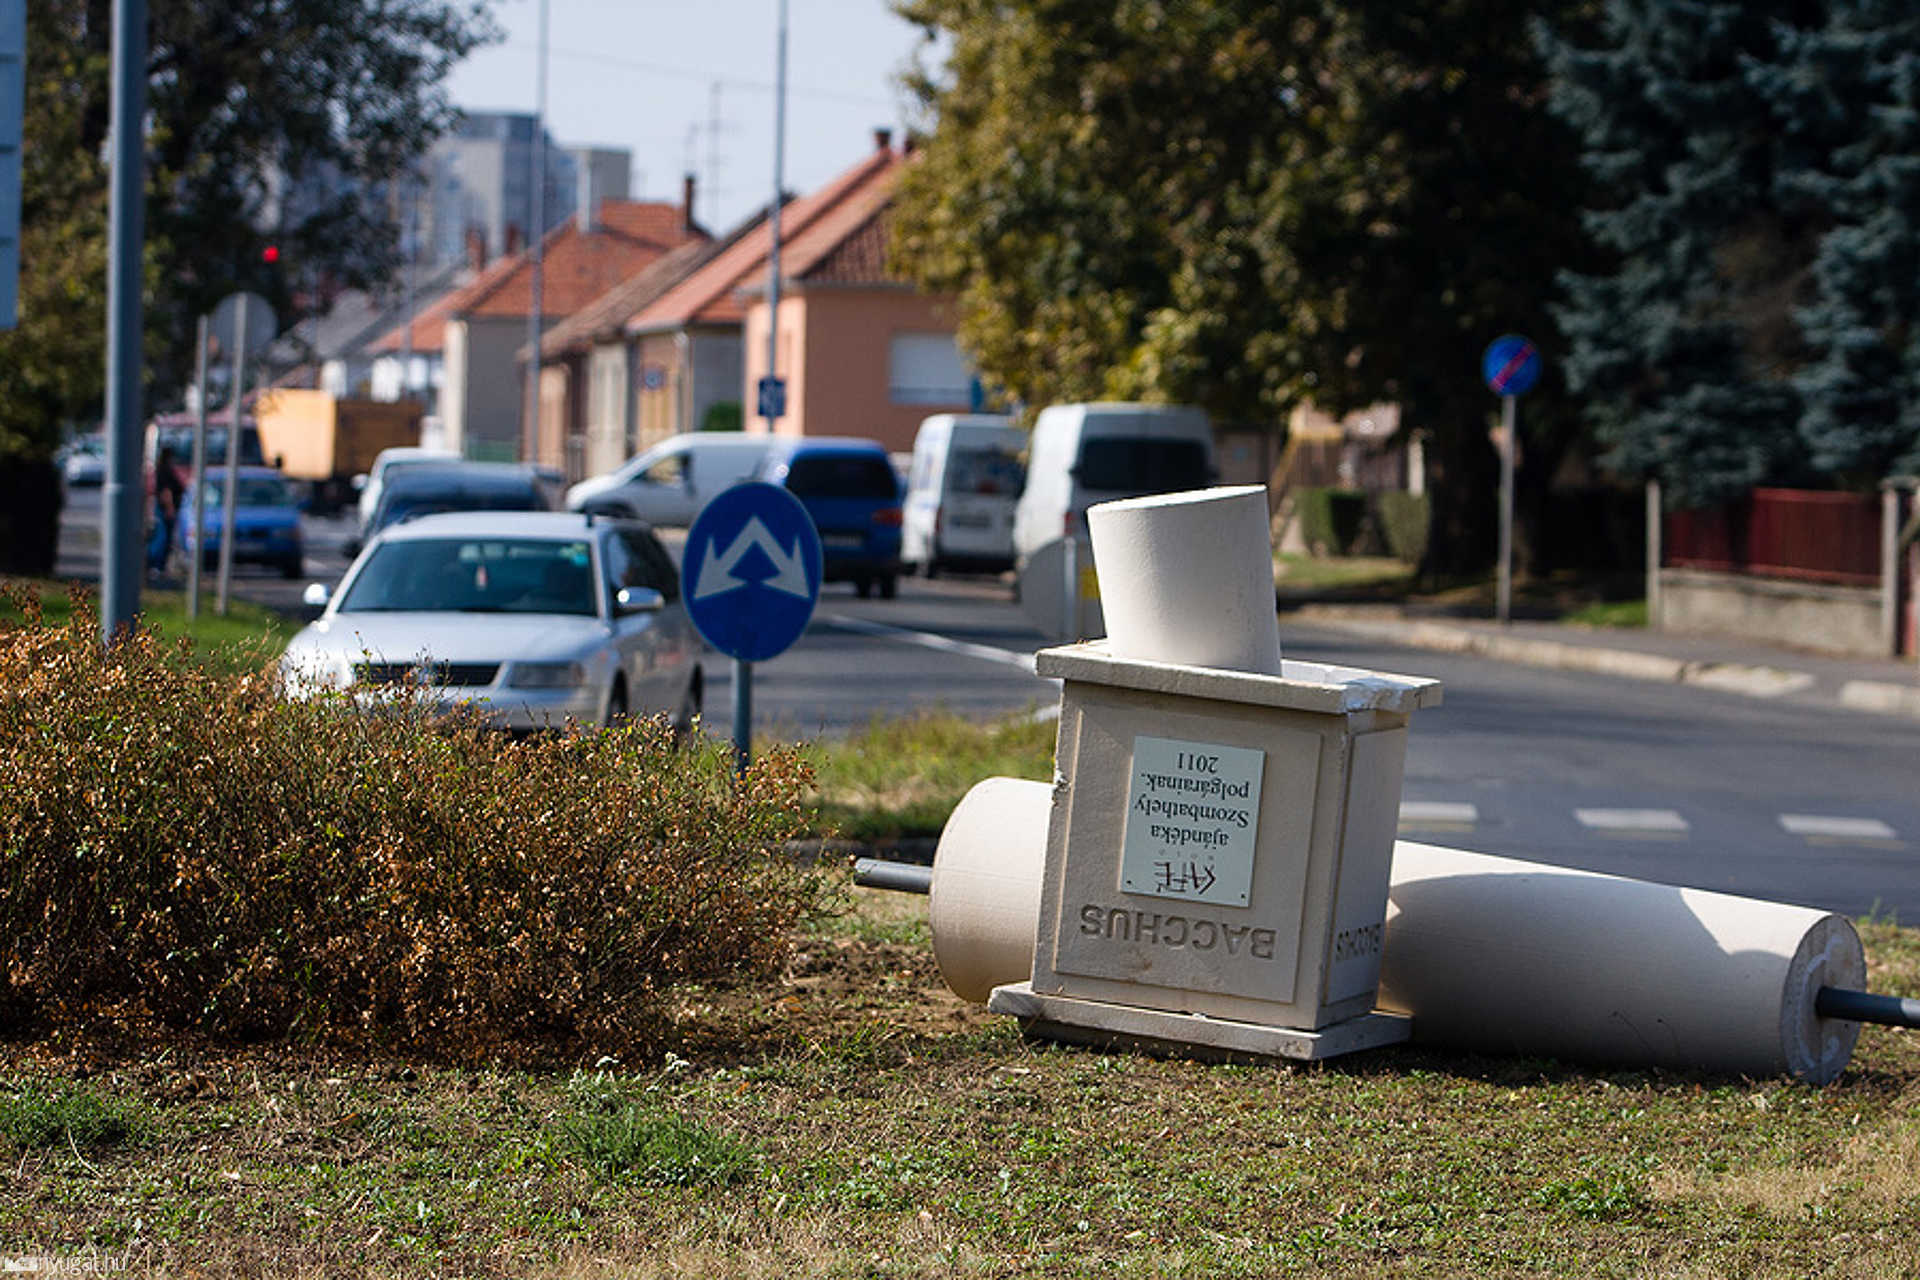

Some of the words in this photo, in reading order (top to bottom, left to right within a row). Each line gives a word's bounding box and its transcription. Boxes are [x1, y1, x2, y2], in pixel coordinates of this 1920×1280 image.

[1177, 752, 1219, 774] 2011
[1141, 772, 1250, 799] polgárainak.
[1134, 794, 1249, 828] Szombathely
[1151, 825, 1230, 850] ajándéka
[1080, 904, 1276, 960] BACCHUS
[1336, 923, 1383, 960] BACCHUS
